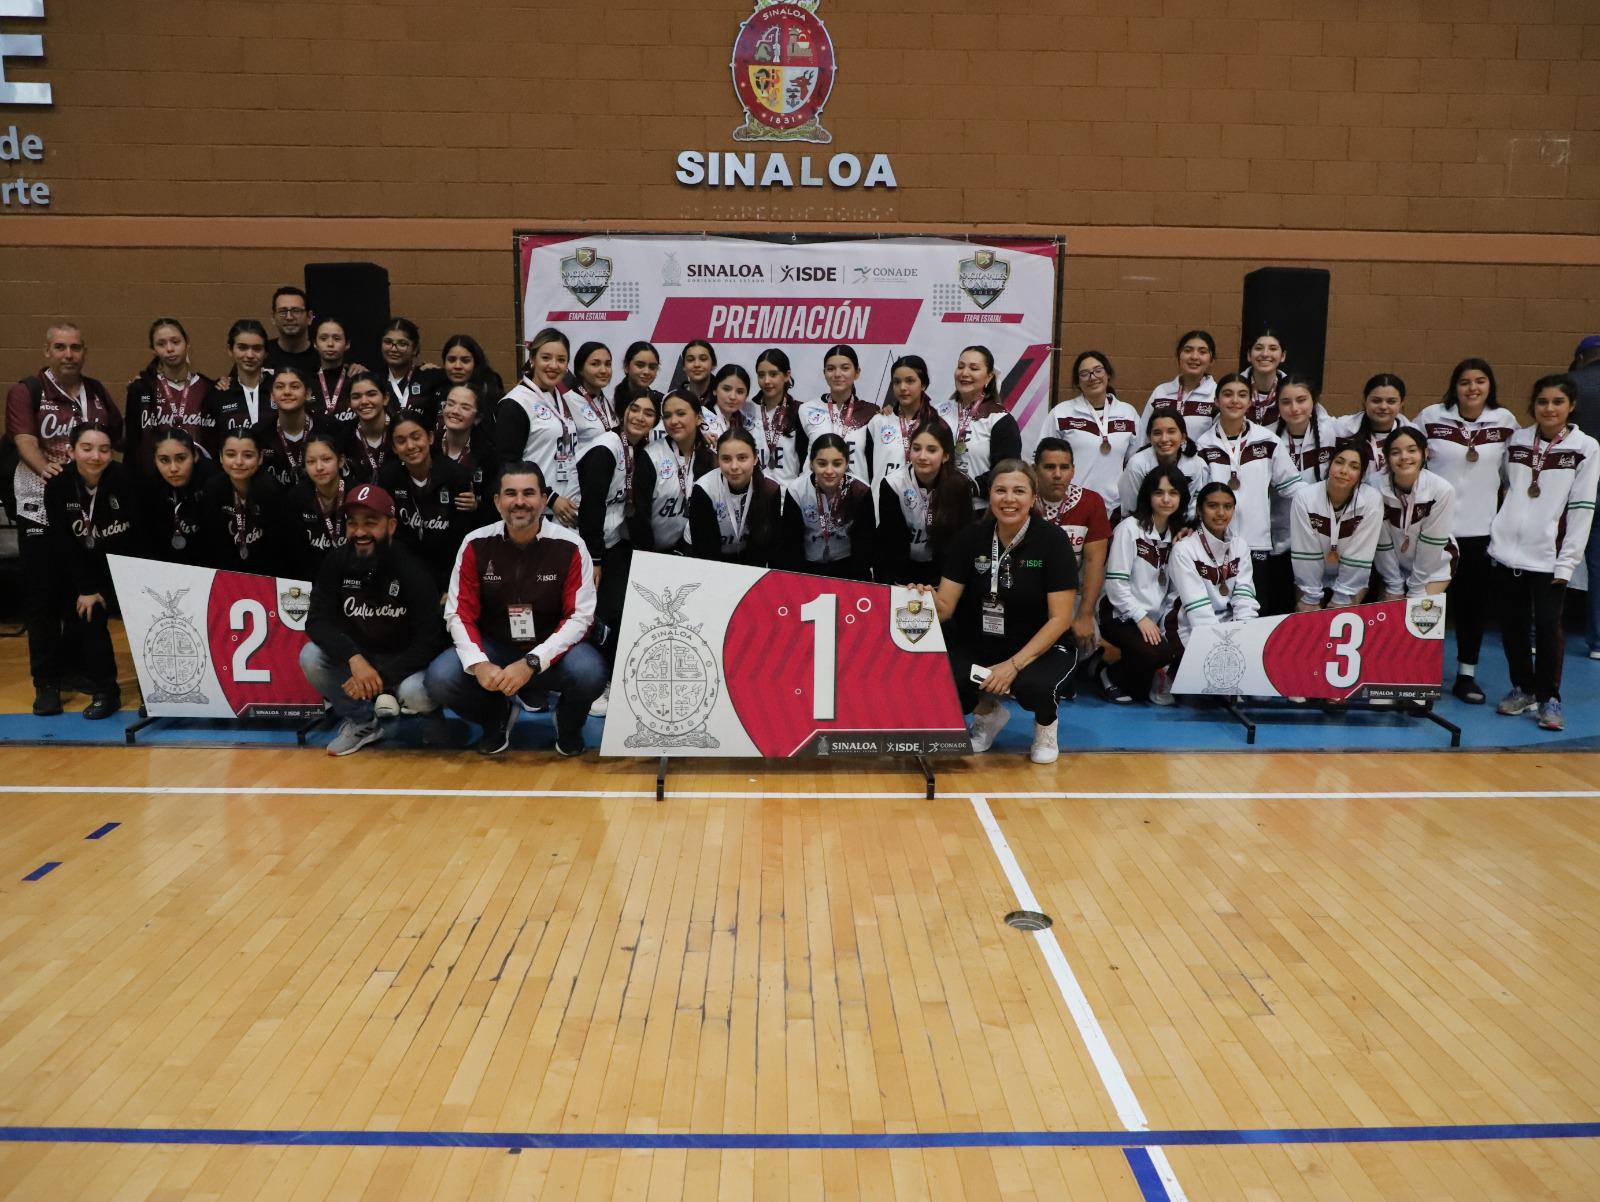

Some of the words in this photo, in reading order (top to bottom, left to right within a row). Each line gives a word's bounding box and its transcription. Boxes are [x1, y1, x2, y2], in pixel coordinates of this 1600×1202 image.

[763, 8, 806, 21] SINALOA
[770, 116, 795, 124] 1831
[0, 125, 44, 161] de
[676, 150, 898, 188] SINALOA
[687, 264, 764, 277] SINALOA
[797, 266, 837, 282] ISDE
[873, 267, 919, 277] CONADE
[568, 312, 585, 321] ETAPA
[586, 312, 607, 321] ESTATAL
[706, 301, 871, 340] PREMIACIÓN
[963, 314, 980, 323] ETAPA
[981, 314, 1003, 323] ESTATAL
[357, 486, 370, 501] C
[1026, 559, 1043, 568] ISDE
[229, 598, 271, 682] 2
[651, 630, 693, 641] SINALOA
[800, 593, 837, 720] 1
[1325, 612, 1365, 688] 3
[831, 742, 878, 750] SINALOA
[895, 742, 920, 752] ISDE
